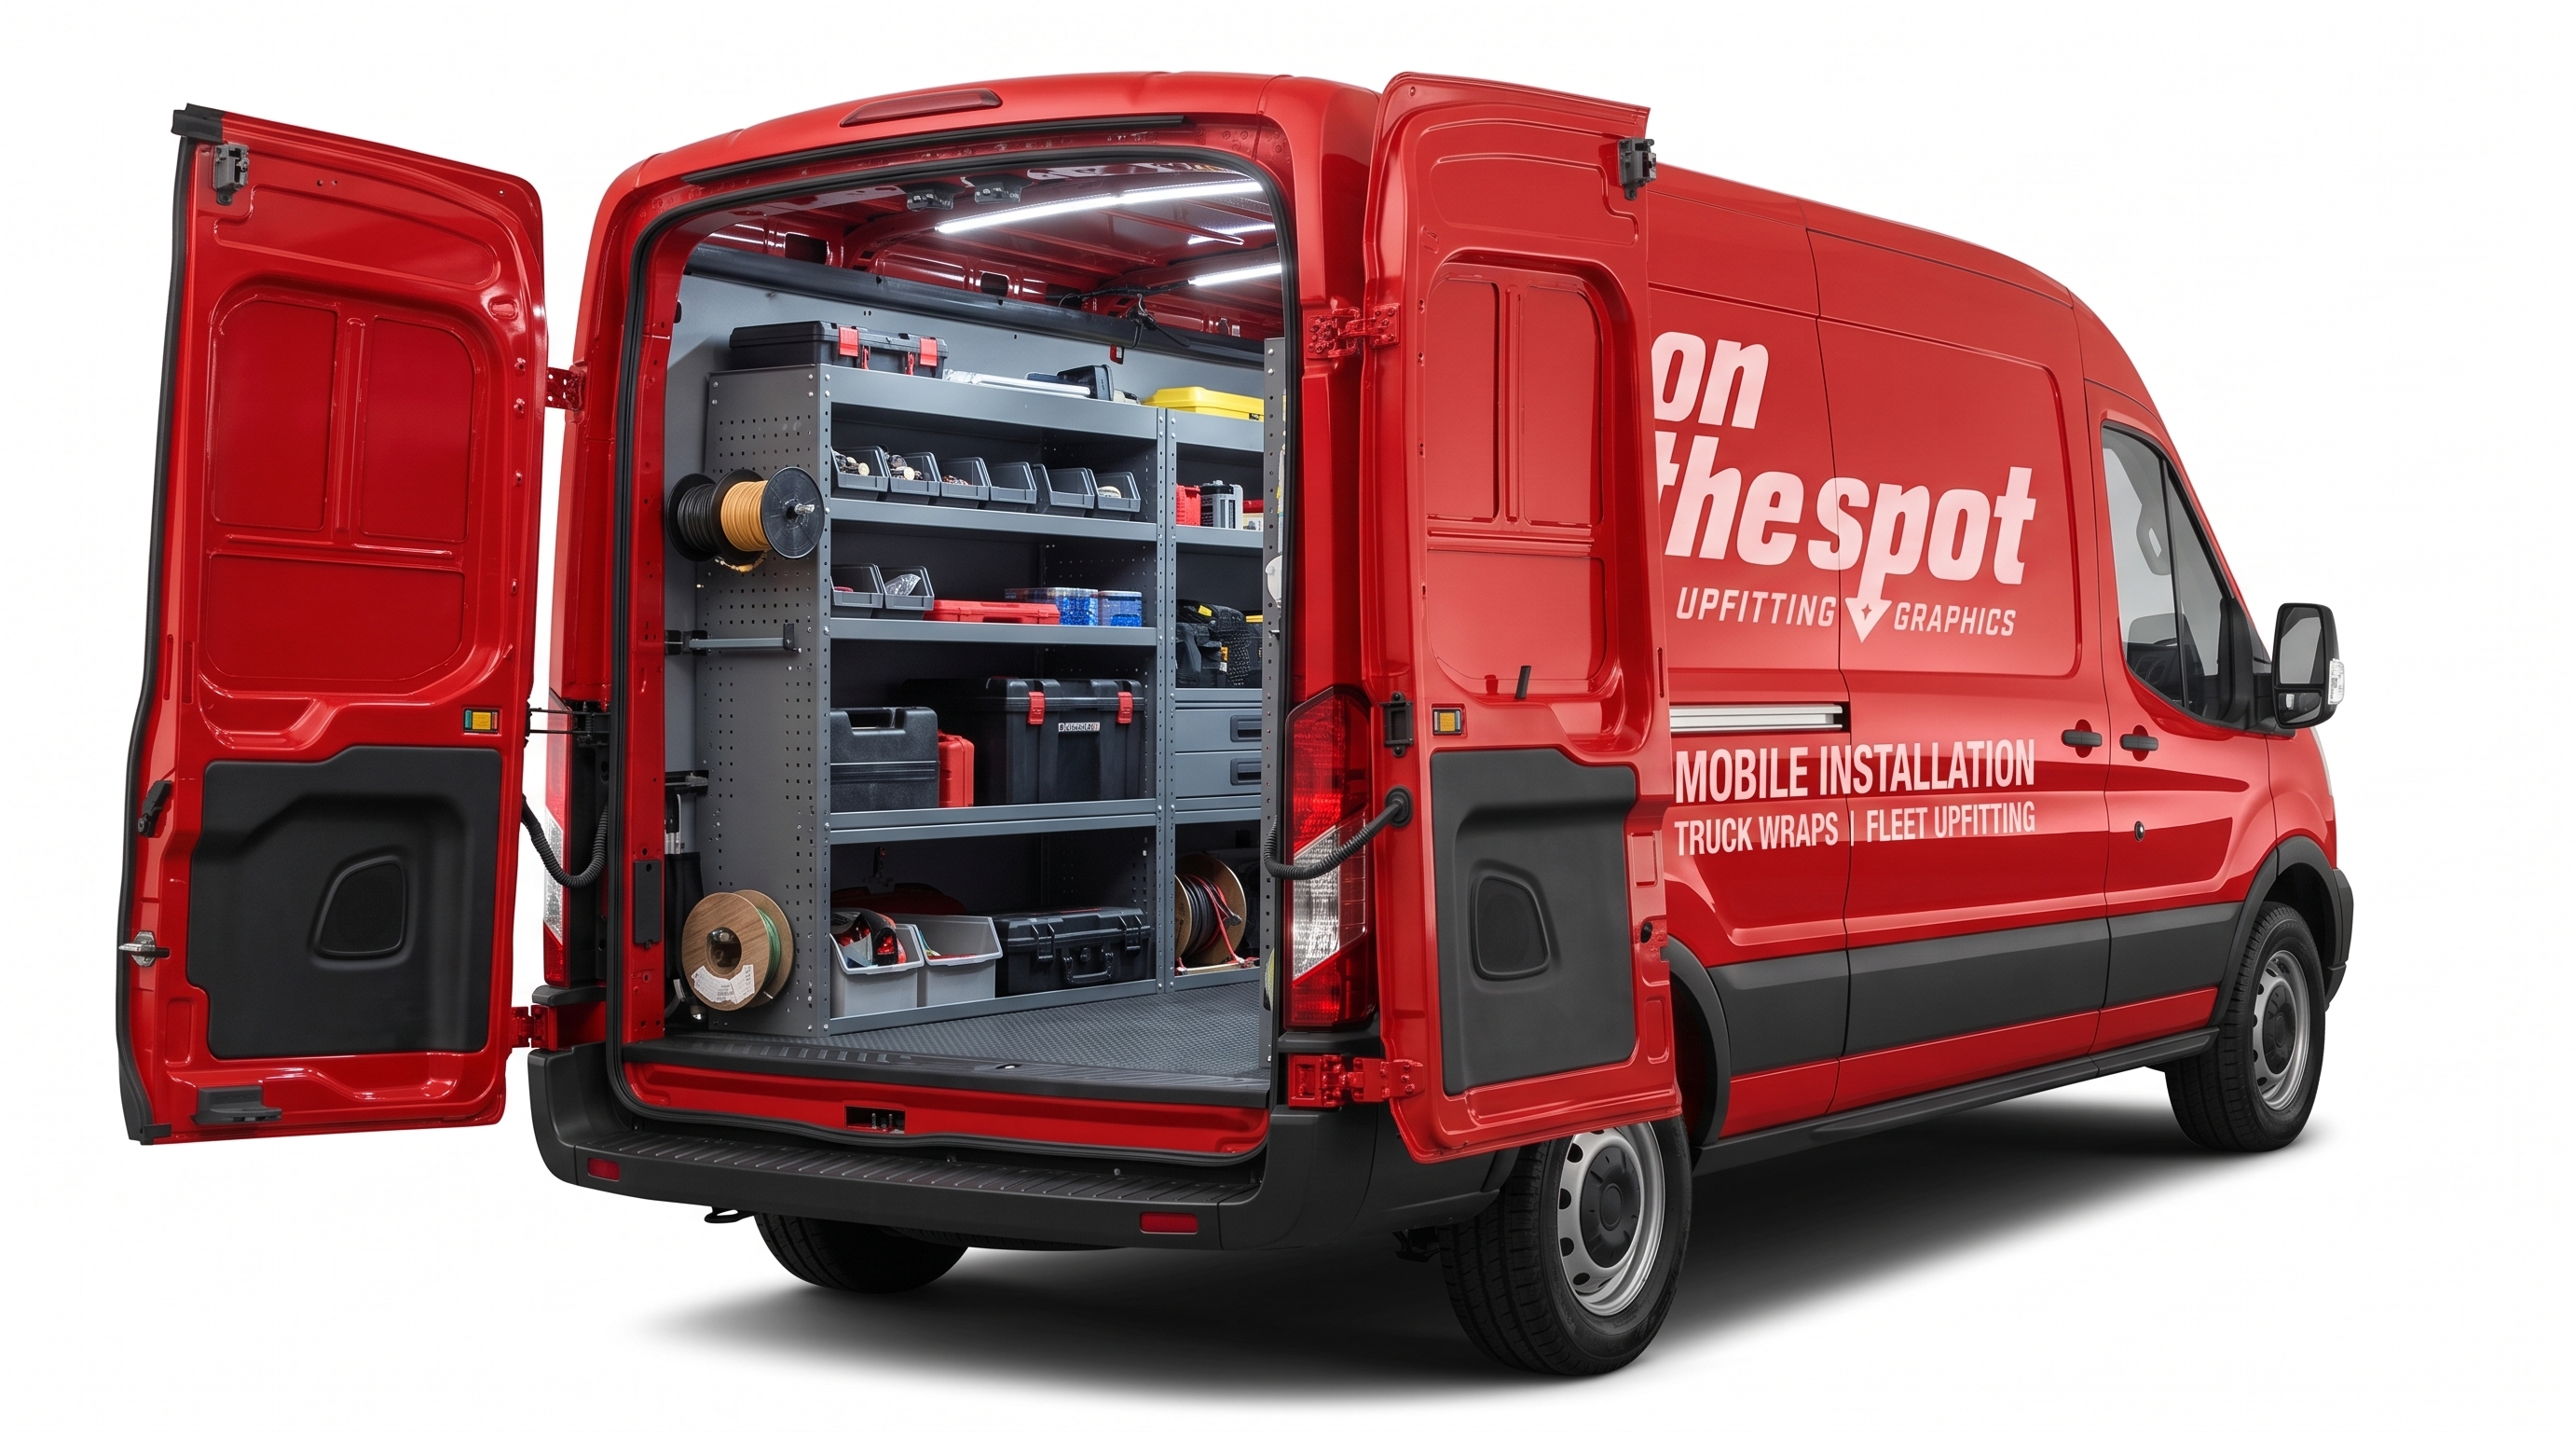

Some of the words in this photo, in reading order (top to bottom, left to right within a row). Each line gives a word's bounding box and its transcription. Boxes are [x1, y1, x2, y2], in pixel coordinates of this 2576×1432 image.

[1651, 331, 1769, 430] on
[1807, 466, 2036, 643] spot
[1676, 586, 1837, 627] UPFITTING
[1893, 601, 2017, 637] GRAPHICS
[1676, 746, 1808, 804] MOBILE
[1820, 738, 2035, 796] INSTALLATION
[1674, 817, 1753, 856] TRUCK
[1759, 811, 1839, 850] WRAPS
[1867, 806, 1928, 843] FLEET
[1934, 801, 2035, 838] UPFITTING
